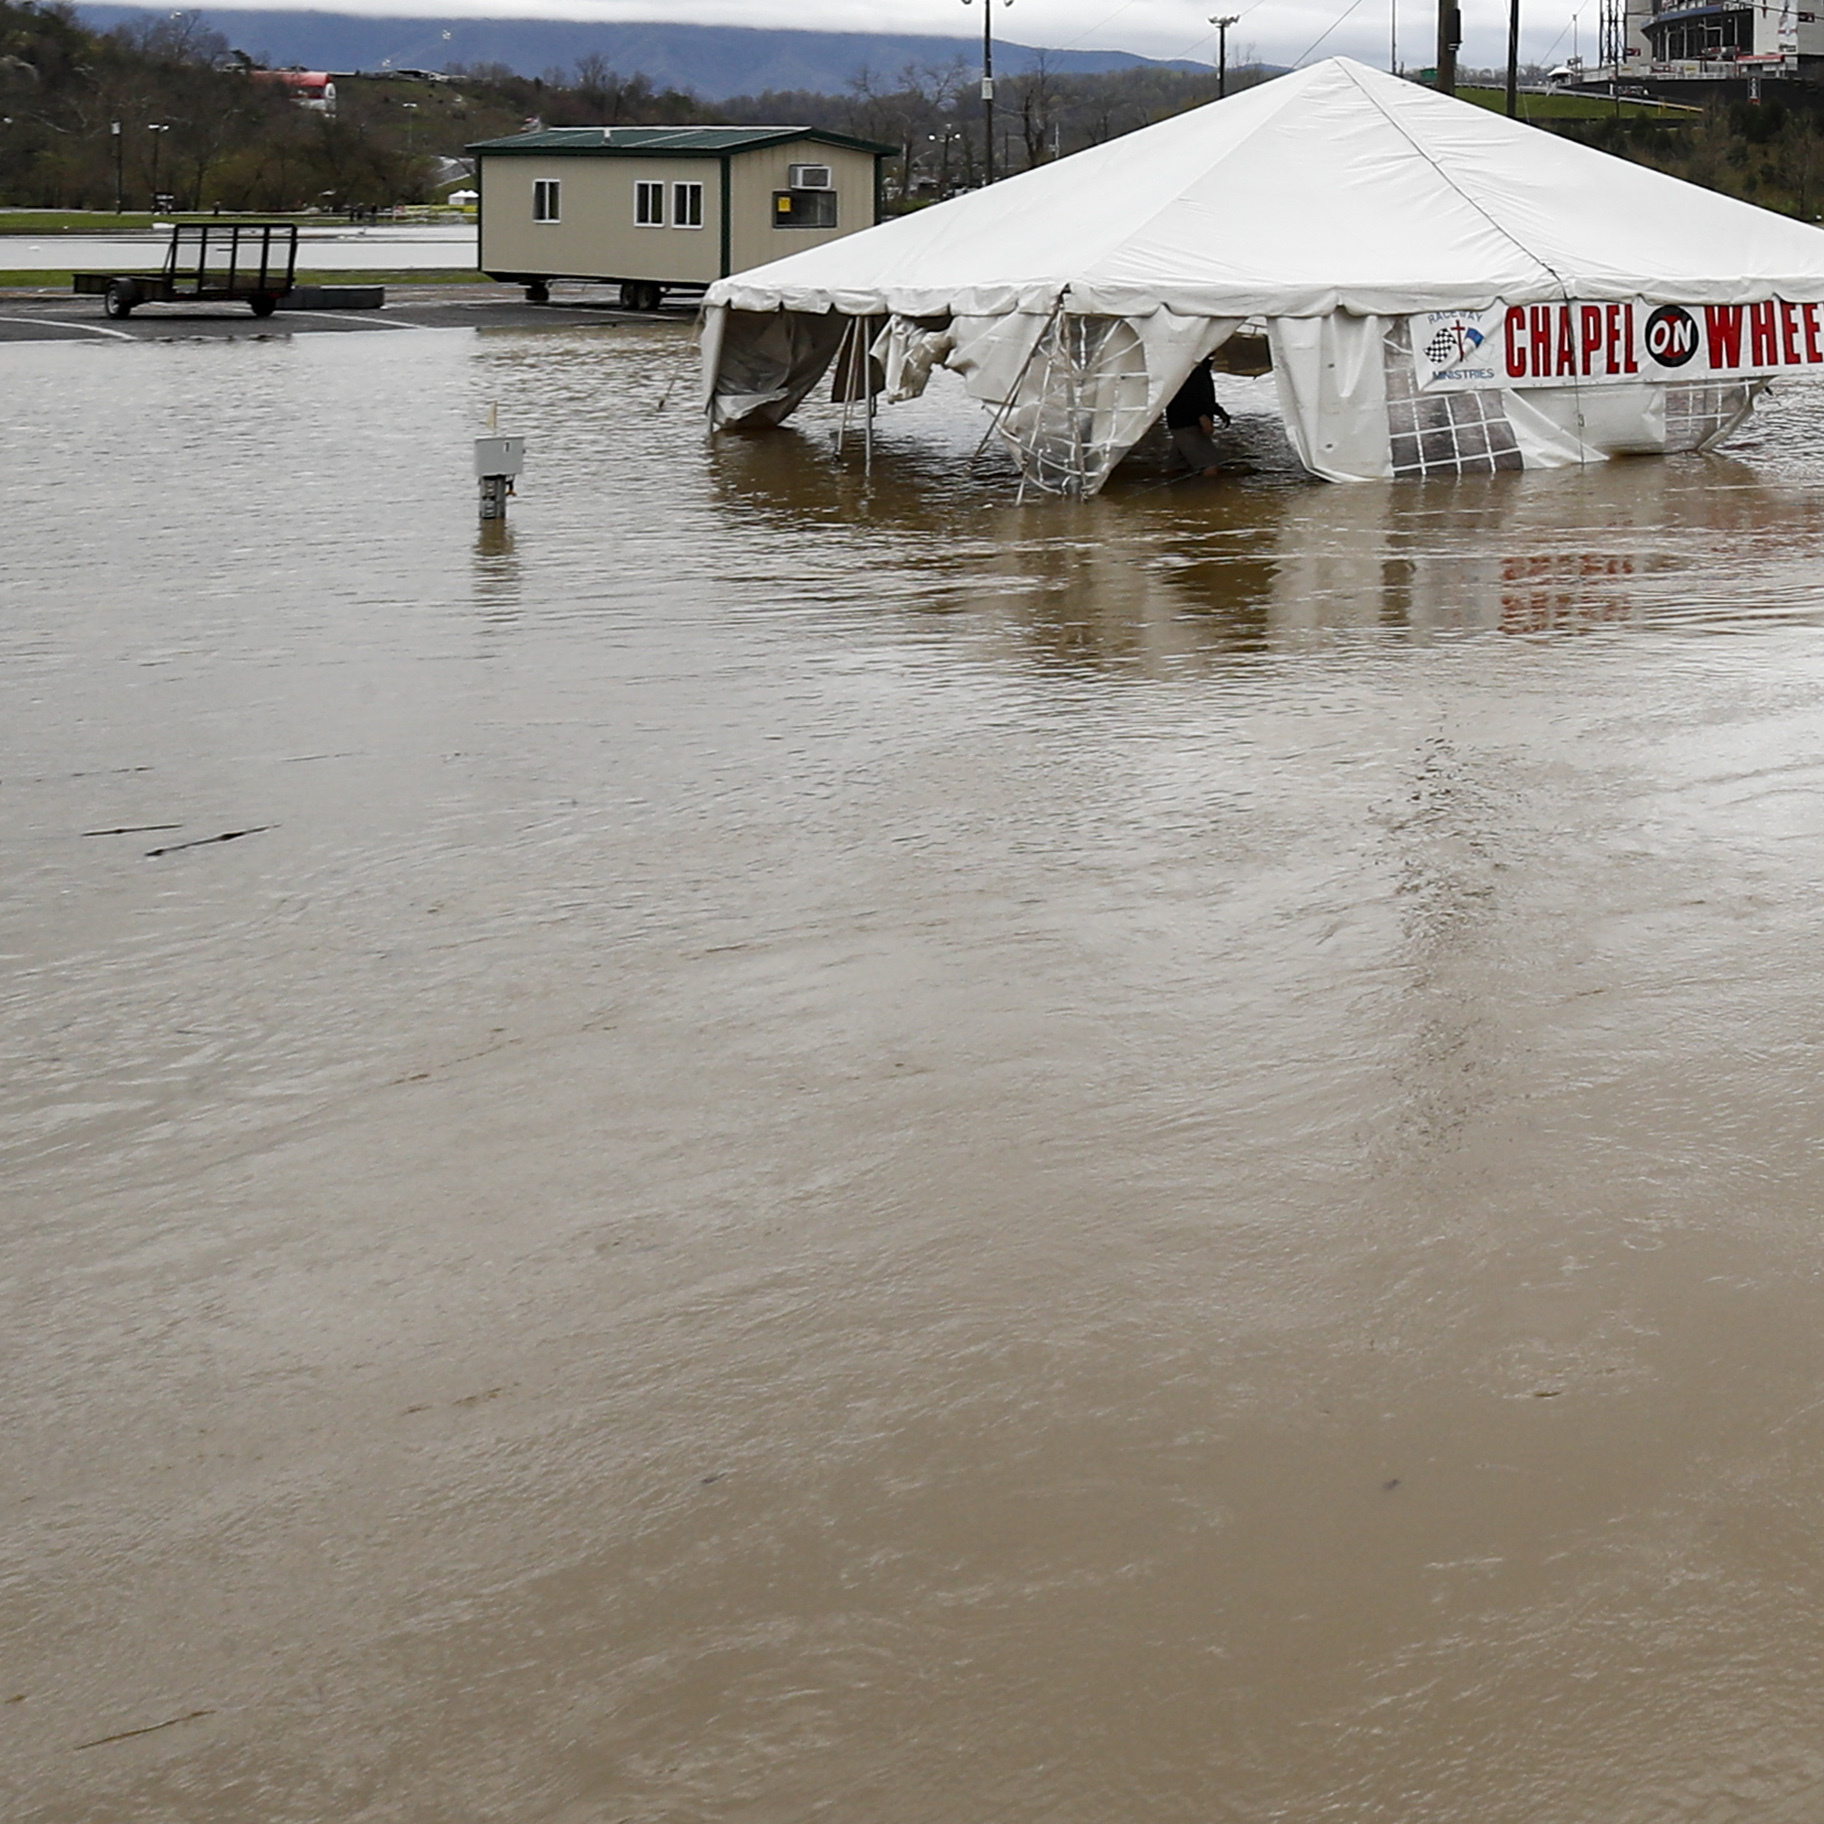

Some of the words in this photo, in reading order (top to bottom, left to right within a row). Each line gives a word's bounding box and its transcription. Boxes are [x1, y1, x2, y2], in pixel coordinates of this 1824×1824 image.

[1427, 310, 1484, 325] RACEWAY
[1504, 303, 1638, 379] CHAPEL
[1650, 319, 1693, 355] ON
[1432, 368, 1495, 380] MINISTRIES
[504, 441, 511, 452] 1
